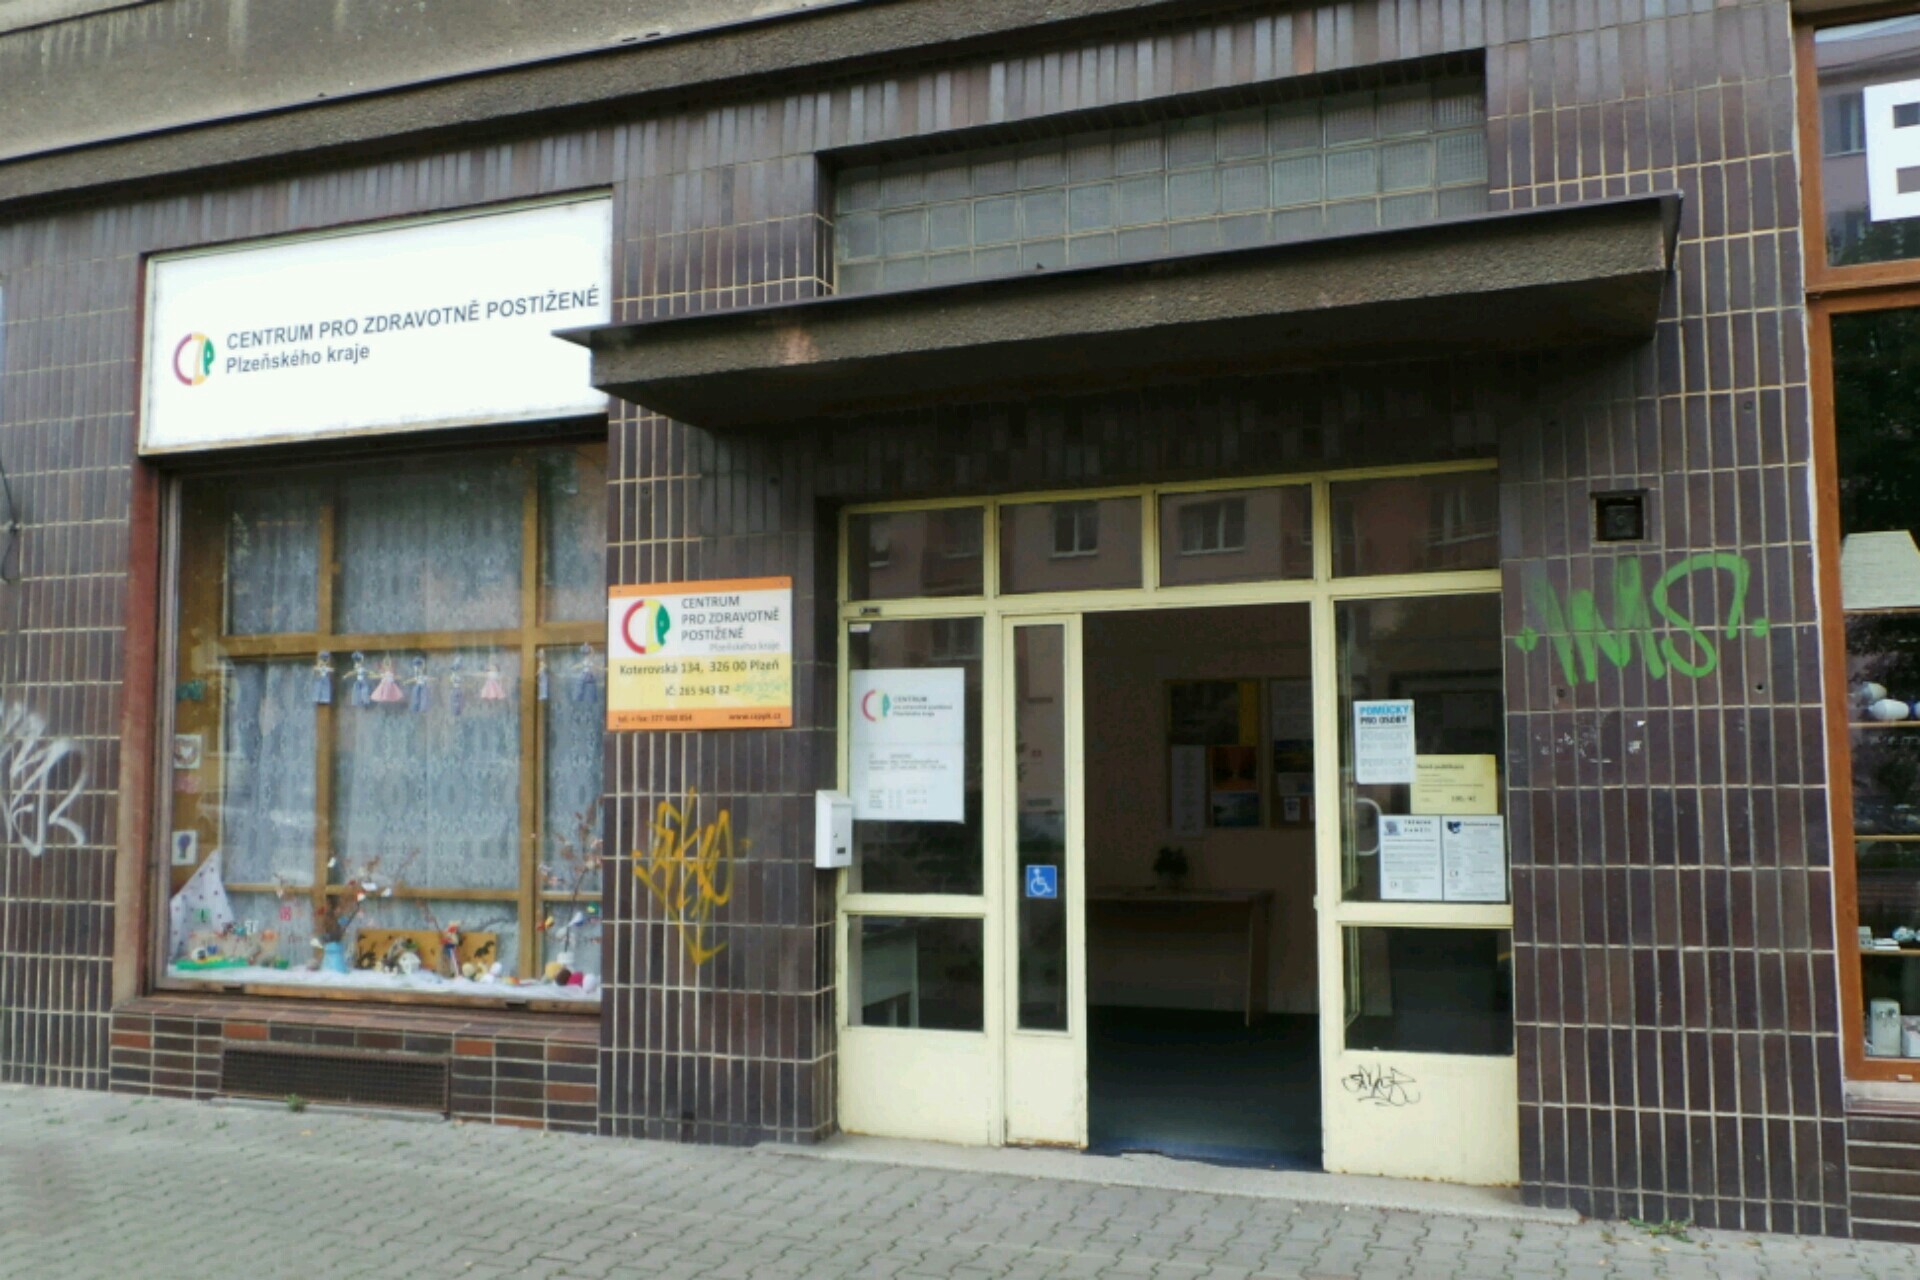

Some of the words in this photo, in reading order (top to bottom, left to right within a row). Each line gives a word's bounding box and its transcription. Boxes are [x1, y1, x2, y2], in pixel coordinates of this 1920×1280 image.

[226, 323, 313, 350] CENTRUM
[319, 318, 358, 339] PRO
[363, 300, 480, 334] ZDRAVOTNĚ
[487, 284, 599, 319] POSTIŽENÉ
[226, 348, 322, 374] Plzeňského
[327, 343, 370, 364] kraje
[681, 595, 740, 610] CENTRUM
[681, 613, 705, 626] PRO
[708, 607, 780, 624] ZDRAVOTNĚ
[681, 627, 744, 642] POSTIŽENÉ
[619, 663, 678, 676] Koterovská
[681, 662, 704, 674] 134,
[709, 661, 730, 672] 326
[732, 661, 747, 671] 00
[750, 659, 780, 671] Plzeň
[1360, 704, 1409, 714] POMŮCKY
[1360, 716, 1377, 725] PRO
